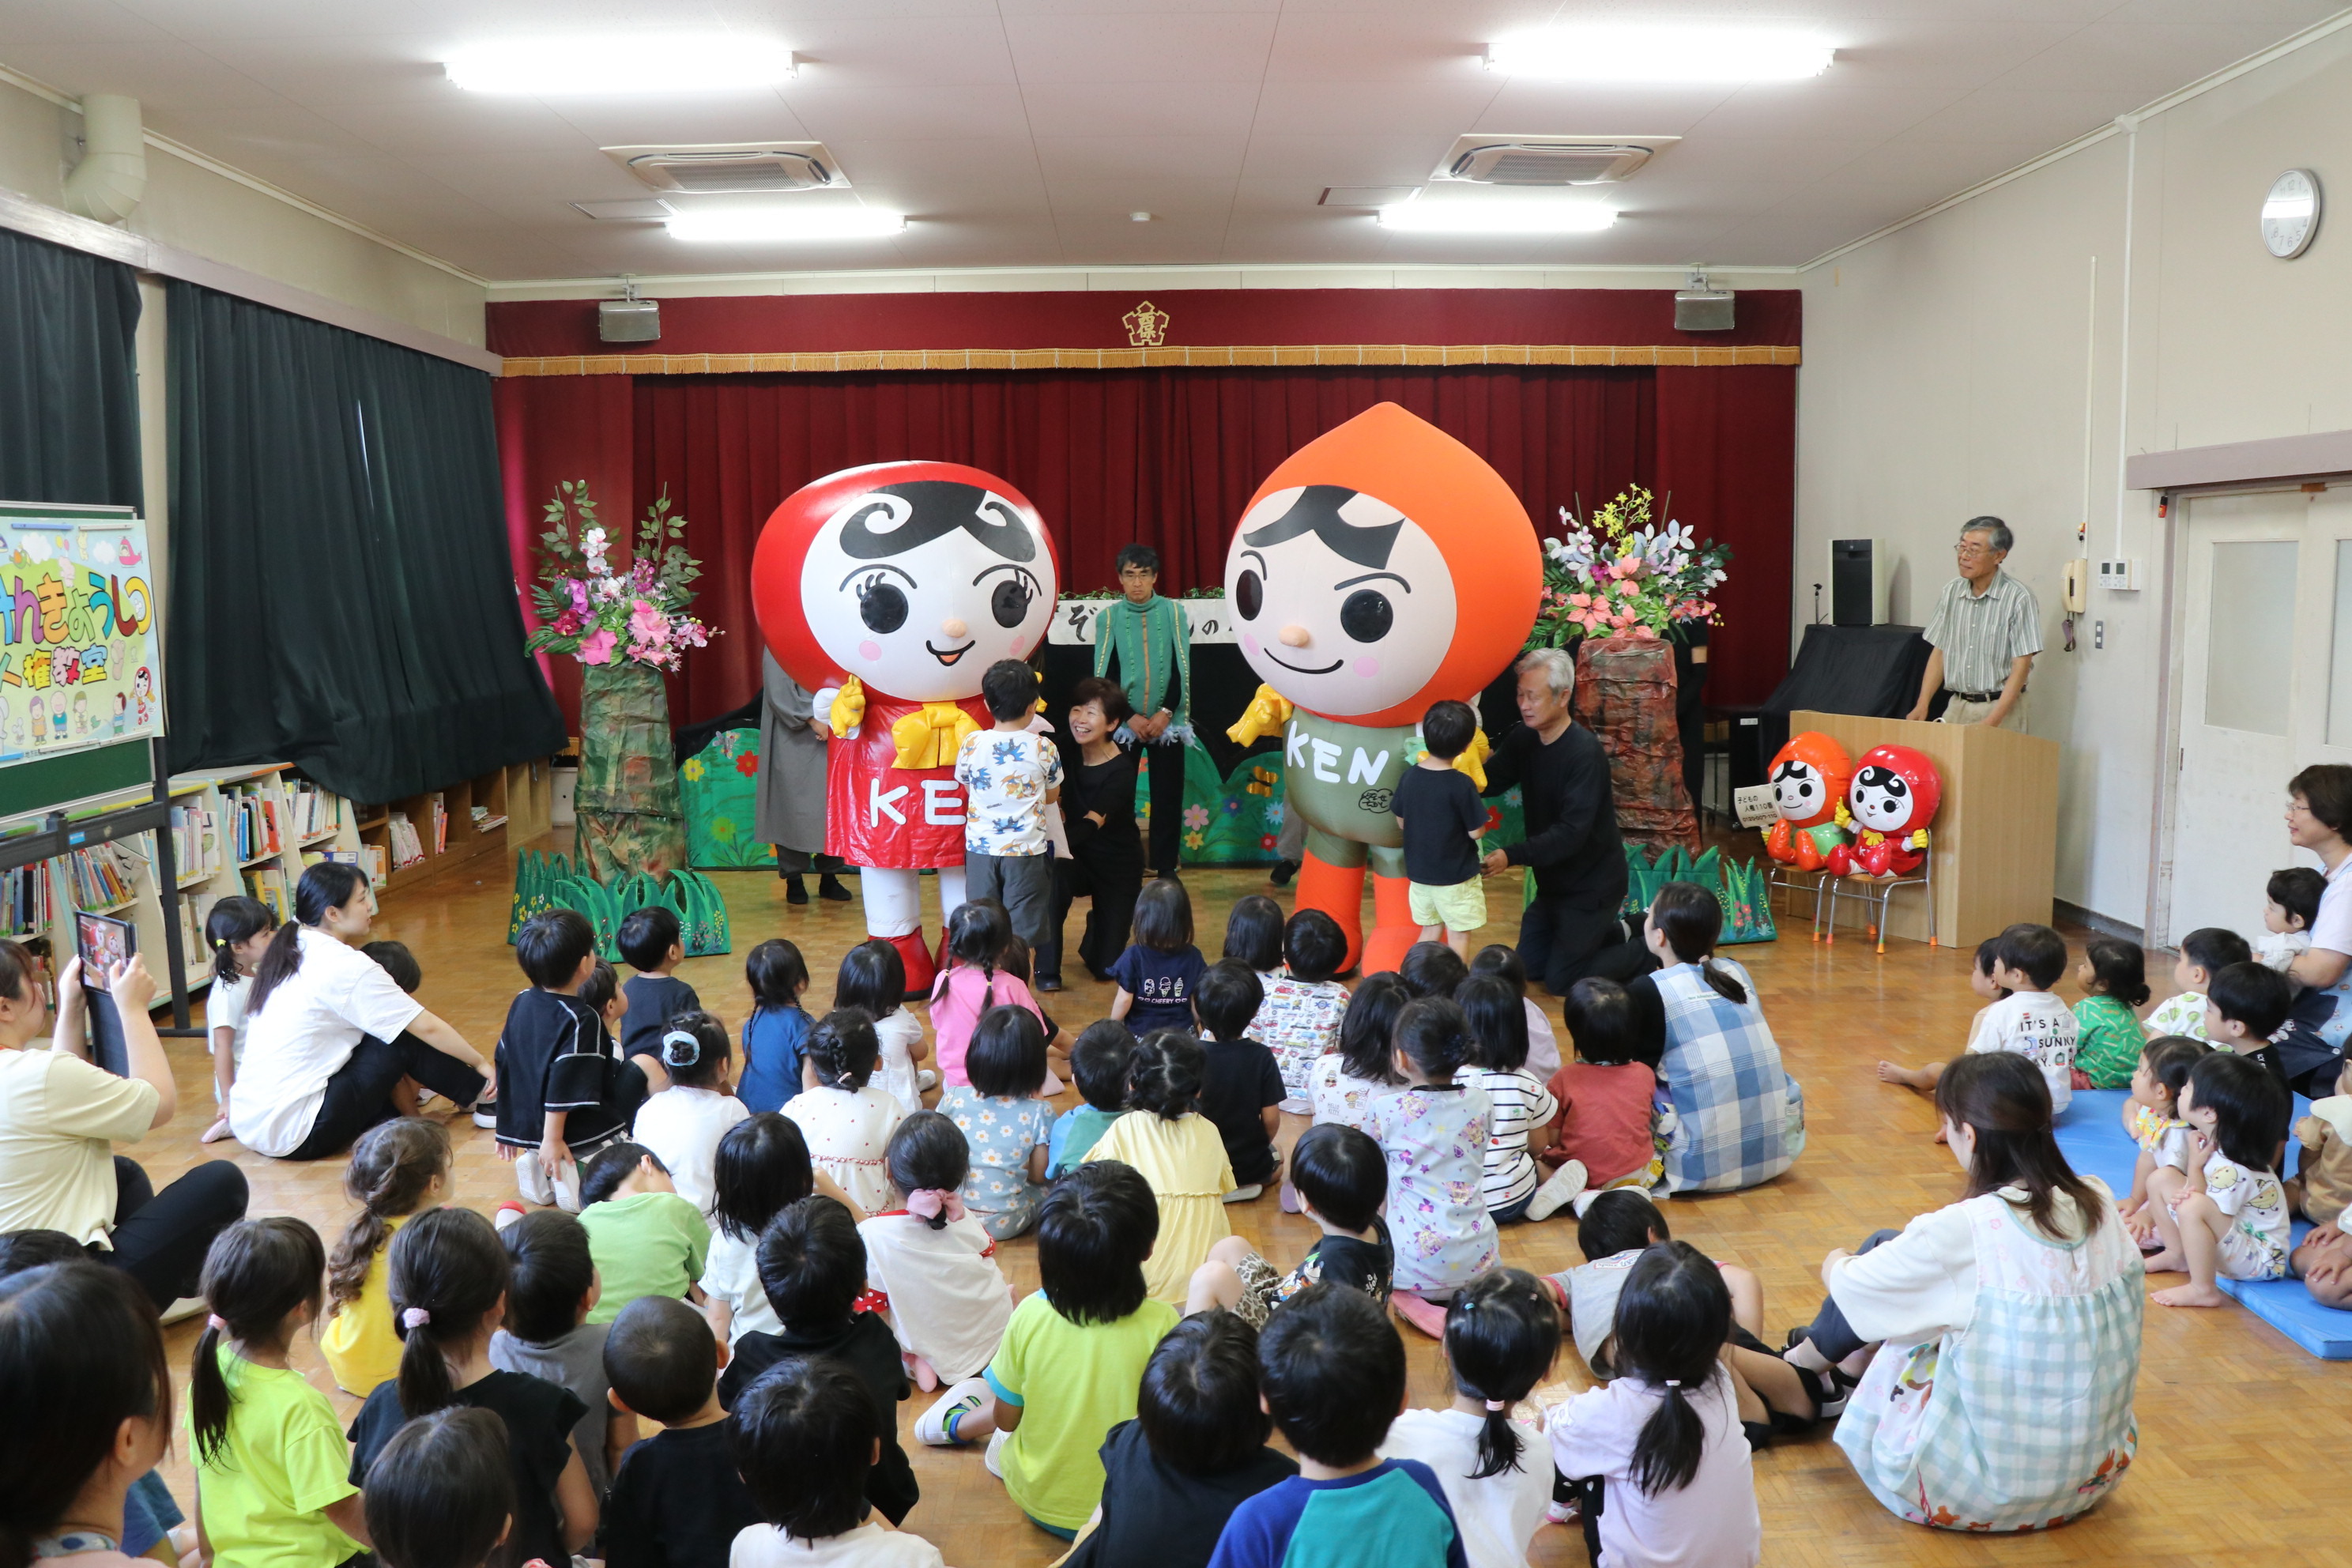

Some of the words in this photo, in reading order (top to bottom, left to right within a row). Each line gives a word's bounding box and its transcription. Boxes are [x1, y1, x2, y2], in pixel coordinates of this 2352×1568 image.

[0, 643, 108, 692] 人権教室
[1287, 720, 1389, 786] KEN
[869, 778, 967, 828] KE
[1737, 795, 1758, 804] 子どもの
[2020, 1019, 2046, 1032] IT'S
[2052, 1018, 2060, 1027] A
[2039, 1036, 2076, 1049] SUNNY
[2034, 1057, 2051, 1068] AY.
